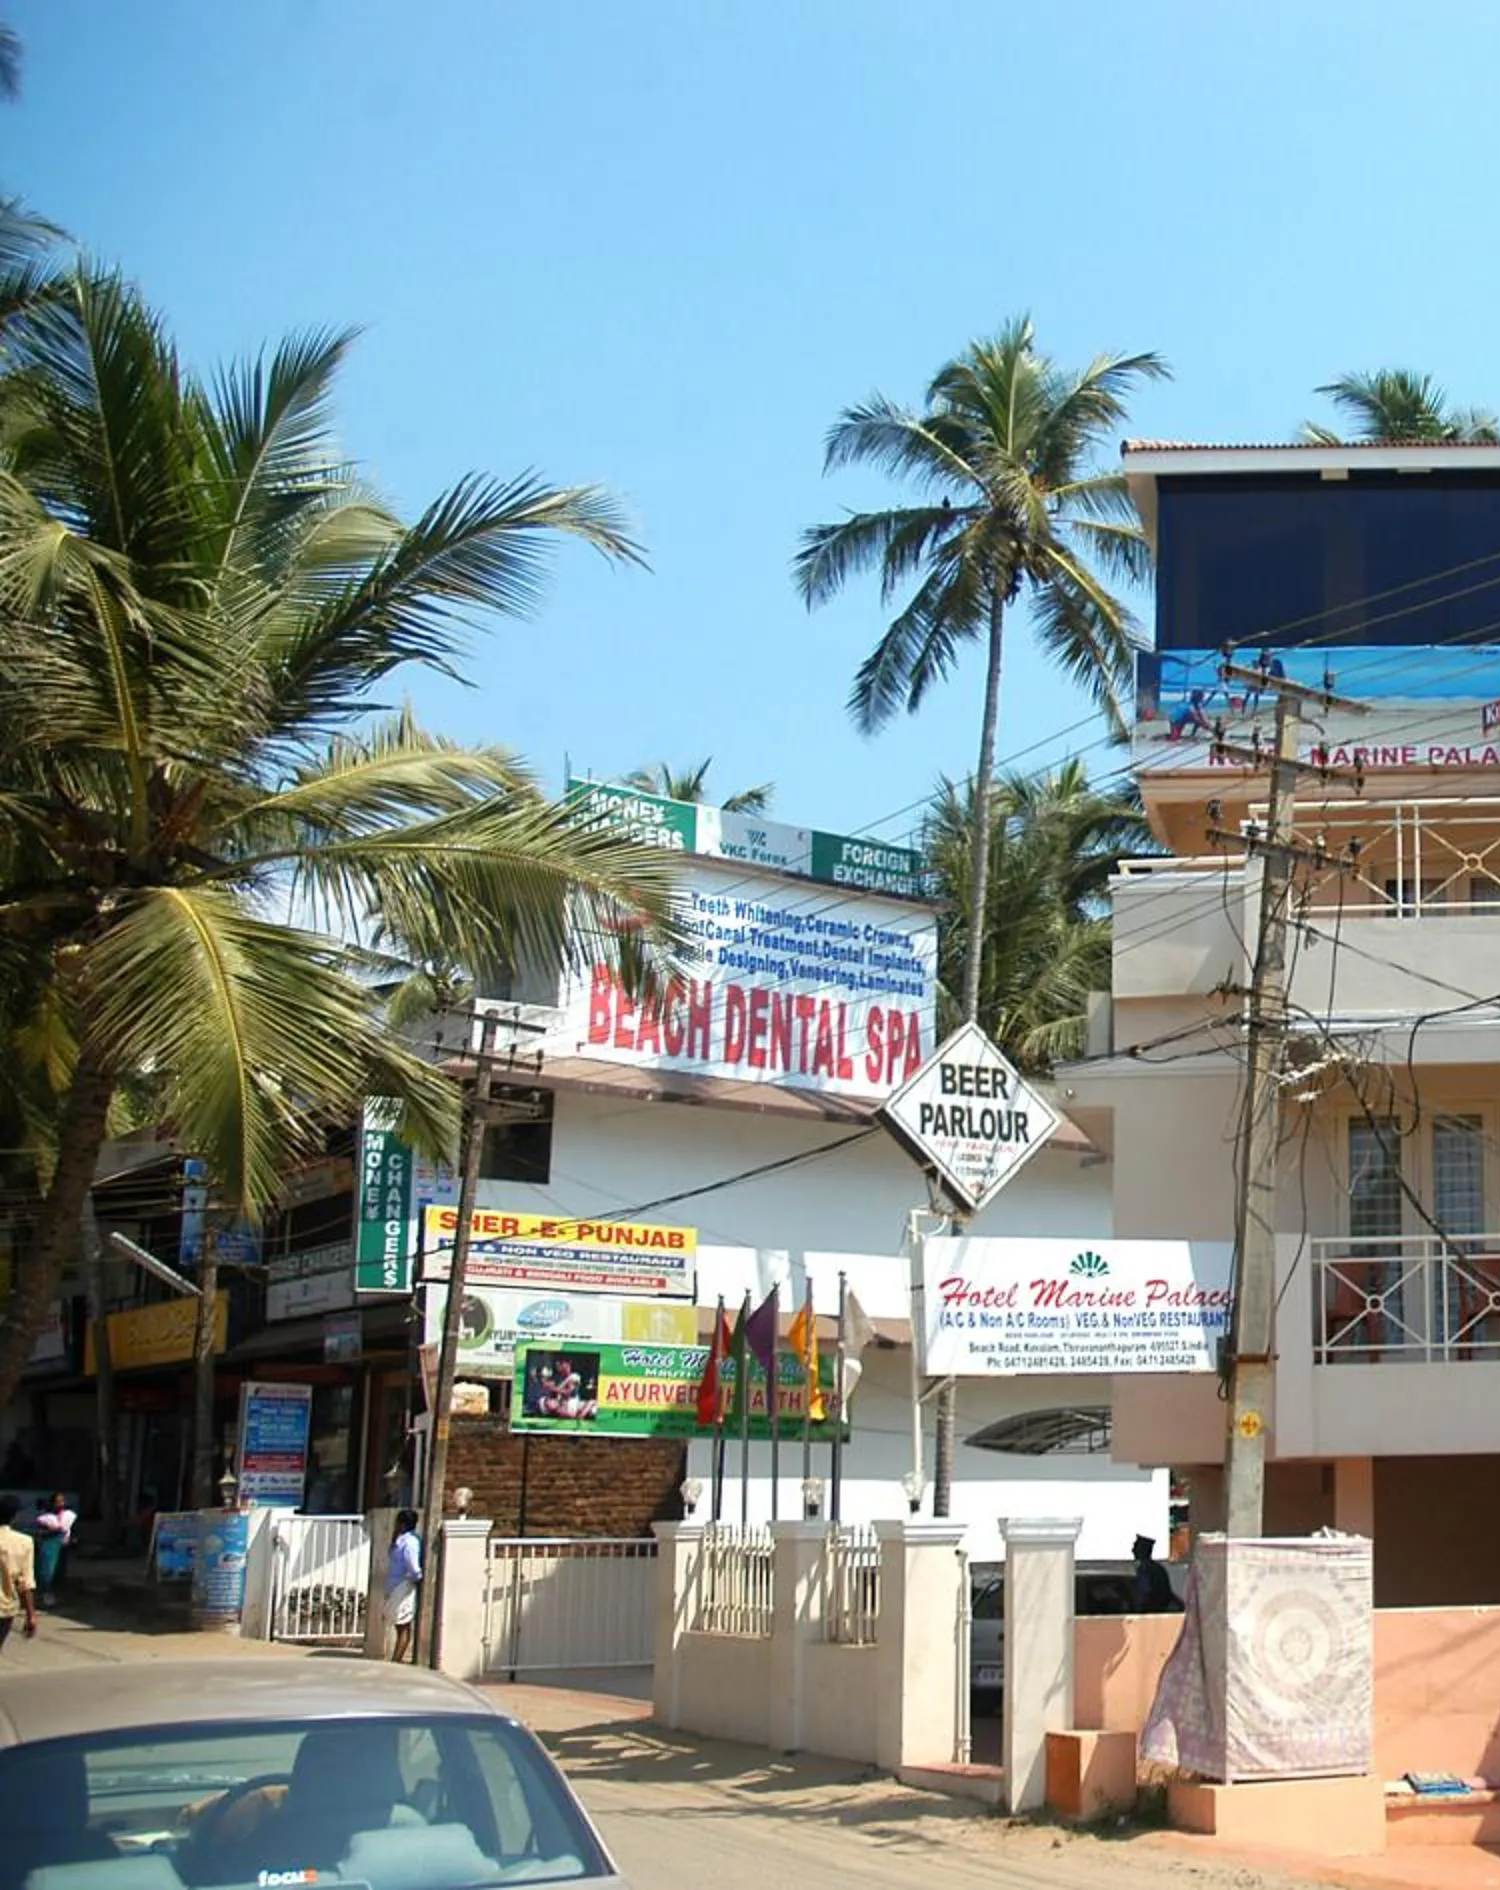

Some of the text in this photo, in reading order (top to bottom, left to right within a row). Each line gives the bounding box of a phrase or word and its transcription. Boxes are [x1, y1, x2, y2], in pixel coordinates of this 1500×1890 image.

[1311, 746, 1416, 766] MARINE
[591, 793, 665, 823] MONEY
[576, 812, 685, 849] CHAGERS
[841, 843, 911, 873] FOREIGN
[833, 864, 921, 896] EXCHANGE
[691, 890, 730, 916] Teeth
[588, 962, 922, 1085] BEACH DENTAL SPA
[940, 1062, 1009, 1100] BEER
[920, 1102, 1030, 1143] PARLOUR
[366, 1133, 385, 1219] MONEY
[438, 1211, 520, 1236] SHER
[577, 1223, 685, 1249] PUNJAB
[441, 1239, 479, 1252] VG
[501, 1245, 537, 1256] NON
[543, 1248, 574, 1259] VEG
[580, 1251, 681, 1268] RESTAURANT
[938, 1276, 1232, 1309] Hotel Marine Palace
[622, 1347, 675, 1367] Hotel
[607, 1381, 712, 1405] AYURVED
[258, 1867, 319, 1888] focus
